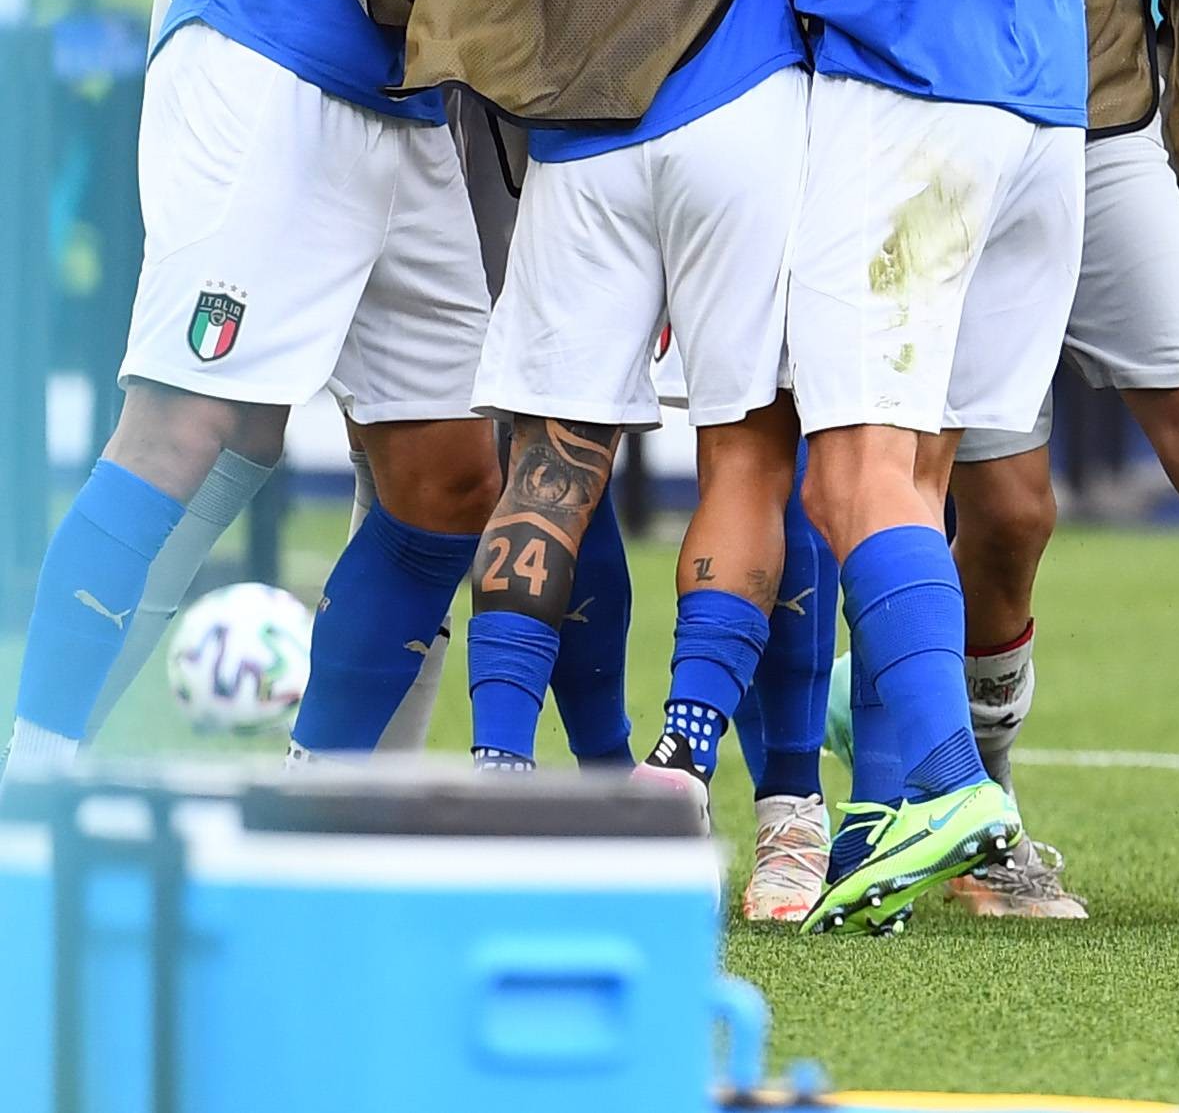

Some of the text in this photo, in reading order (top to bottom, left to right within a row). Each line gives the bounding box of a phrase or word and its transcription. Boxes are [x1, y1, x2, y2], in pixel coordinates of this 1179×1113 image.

[200, 295, 242, 317] ITALIA
[482, 537, 548, 596] 24
[693, 556, 716, 582] L
